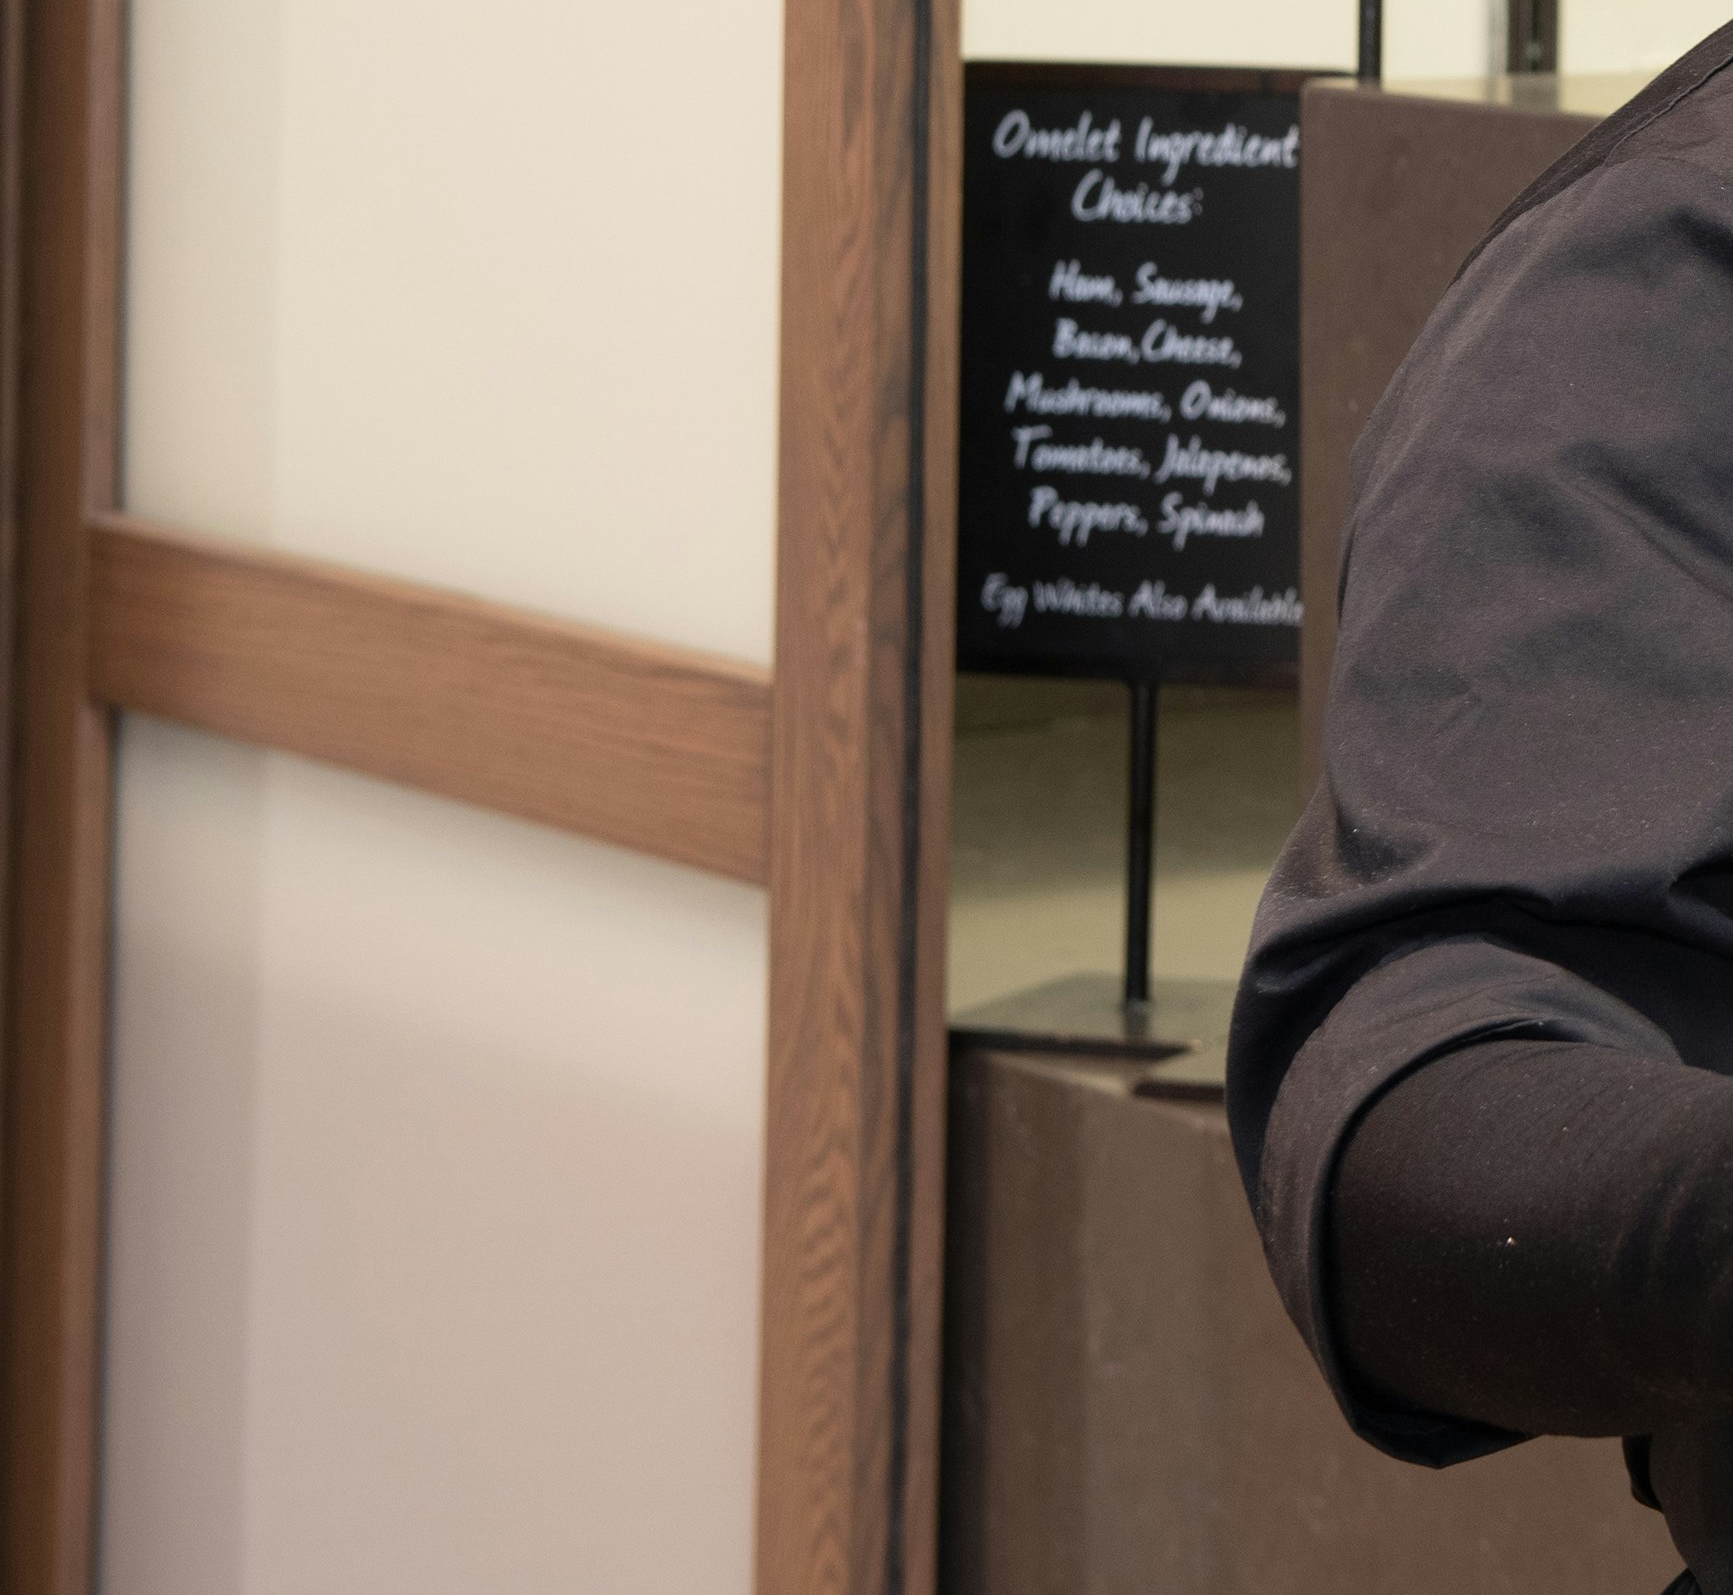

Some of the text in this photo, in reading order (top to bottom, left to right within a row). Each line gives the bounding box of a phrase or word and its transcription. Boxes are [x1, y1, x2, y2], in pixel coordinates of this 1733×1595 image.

[993, 108, 1121, 162] Omelet
[1050, 259, 1244, 325] Ham, Sausage,
[1052, 317, 1243, 368] Bacon, Cheese,
[1005, 370, 1287, 429] Mushrooms, Onions,
[1011, 423, 1293, 497] Tomatoes, Jalapenos,
[1029, 485, 1265, 551] Peppers, Spinach
[980, 572, 1029, 629] Egg
[1031, 576, 1125, 618] Whites
[1127, 580, 1188, 621] Also
